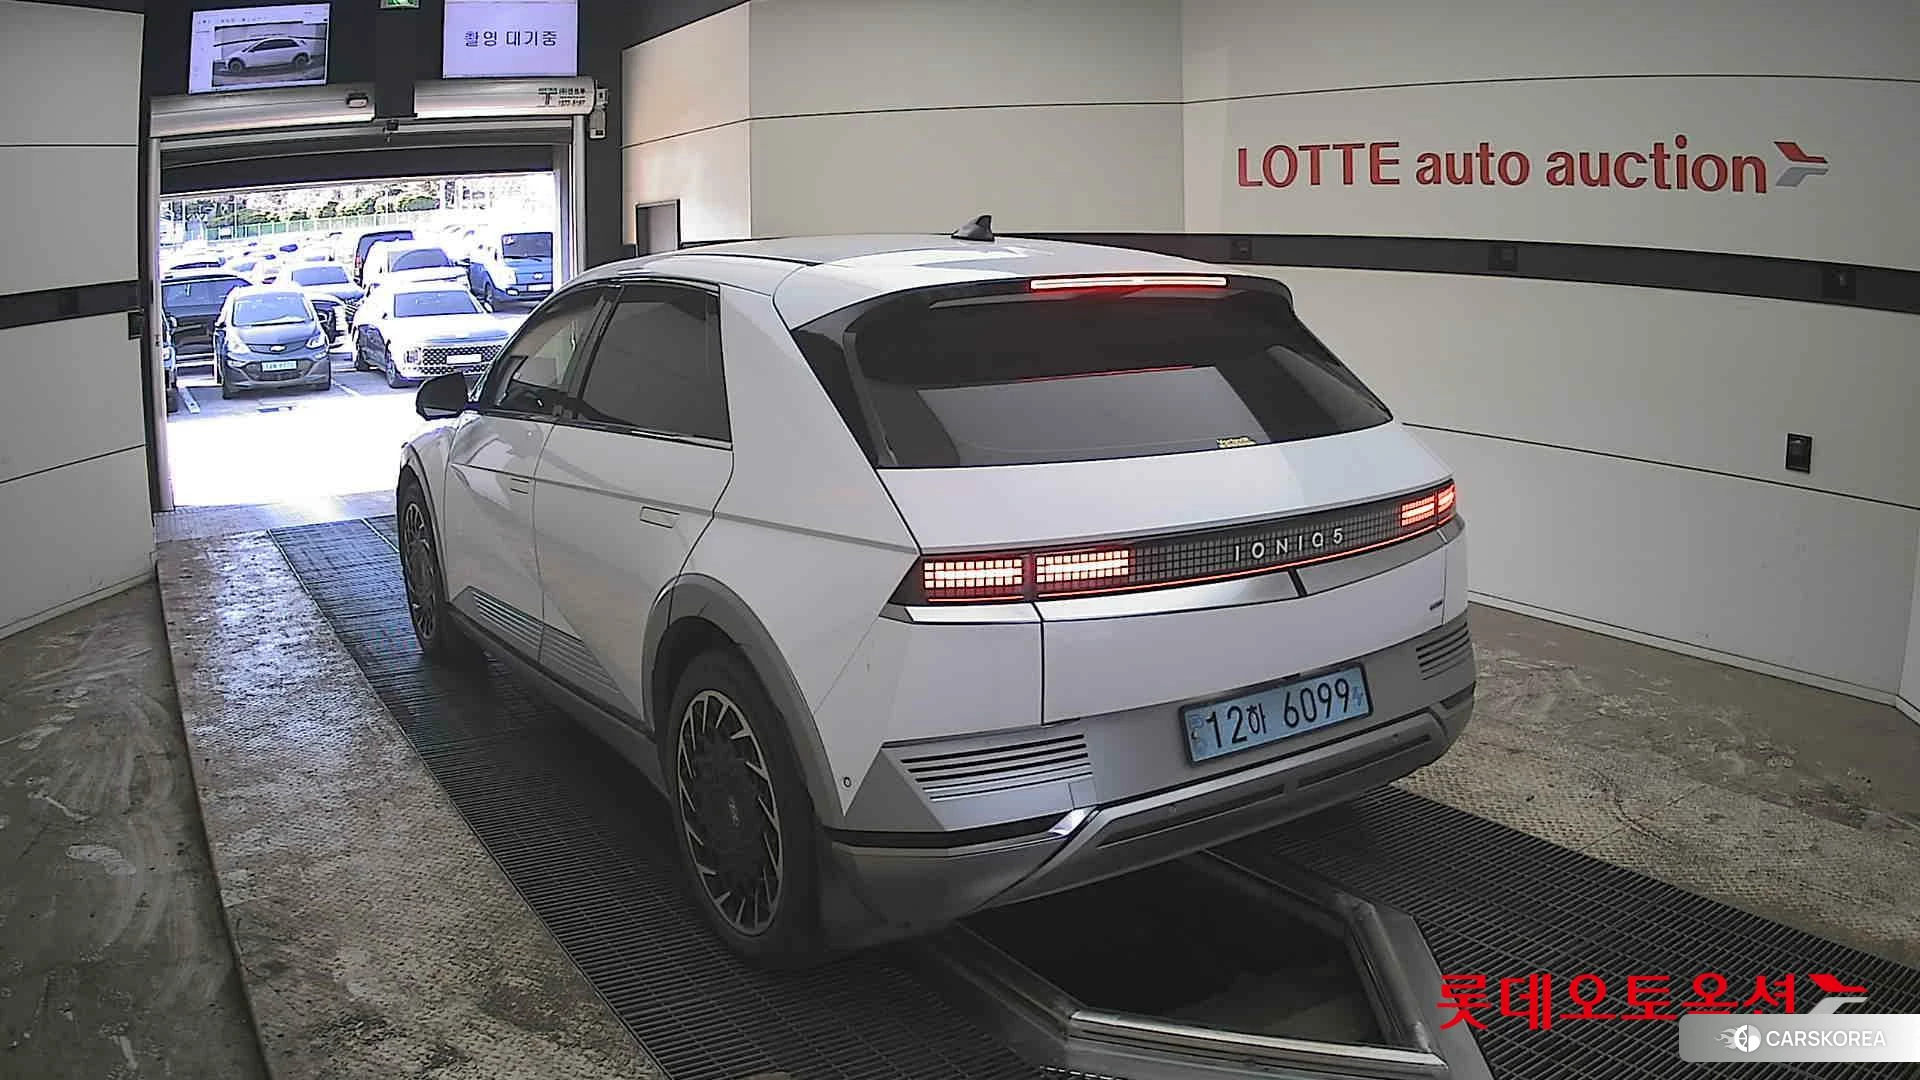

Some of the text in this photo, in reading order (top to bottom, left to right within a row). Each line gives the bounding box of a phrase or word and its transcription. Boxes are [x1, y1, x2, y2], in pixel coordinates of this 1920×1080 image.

[505, 30, 558, 47] 대기중
[1238, 134, 1767, 194] LOTTE auto auction
[1206, 678, 1350, 748] 12하 6099
